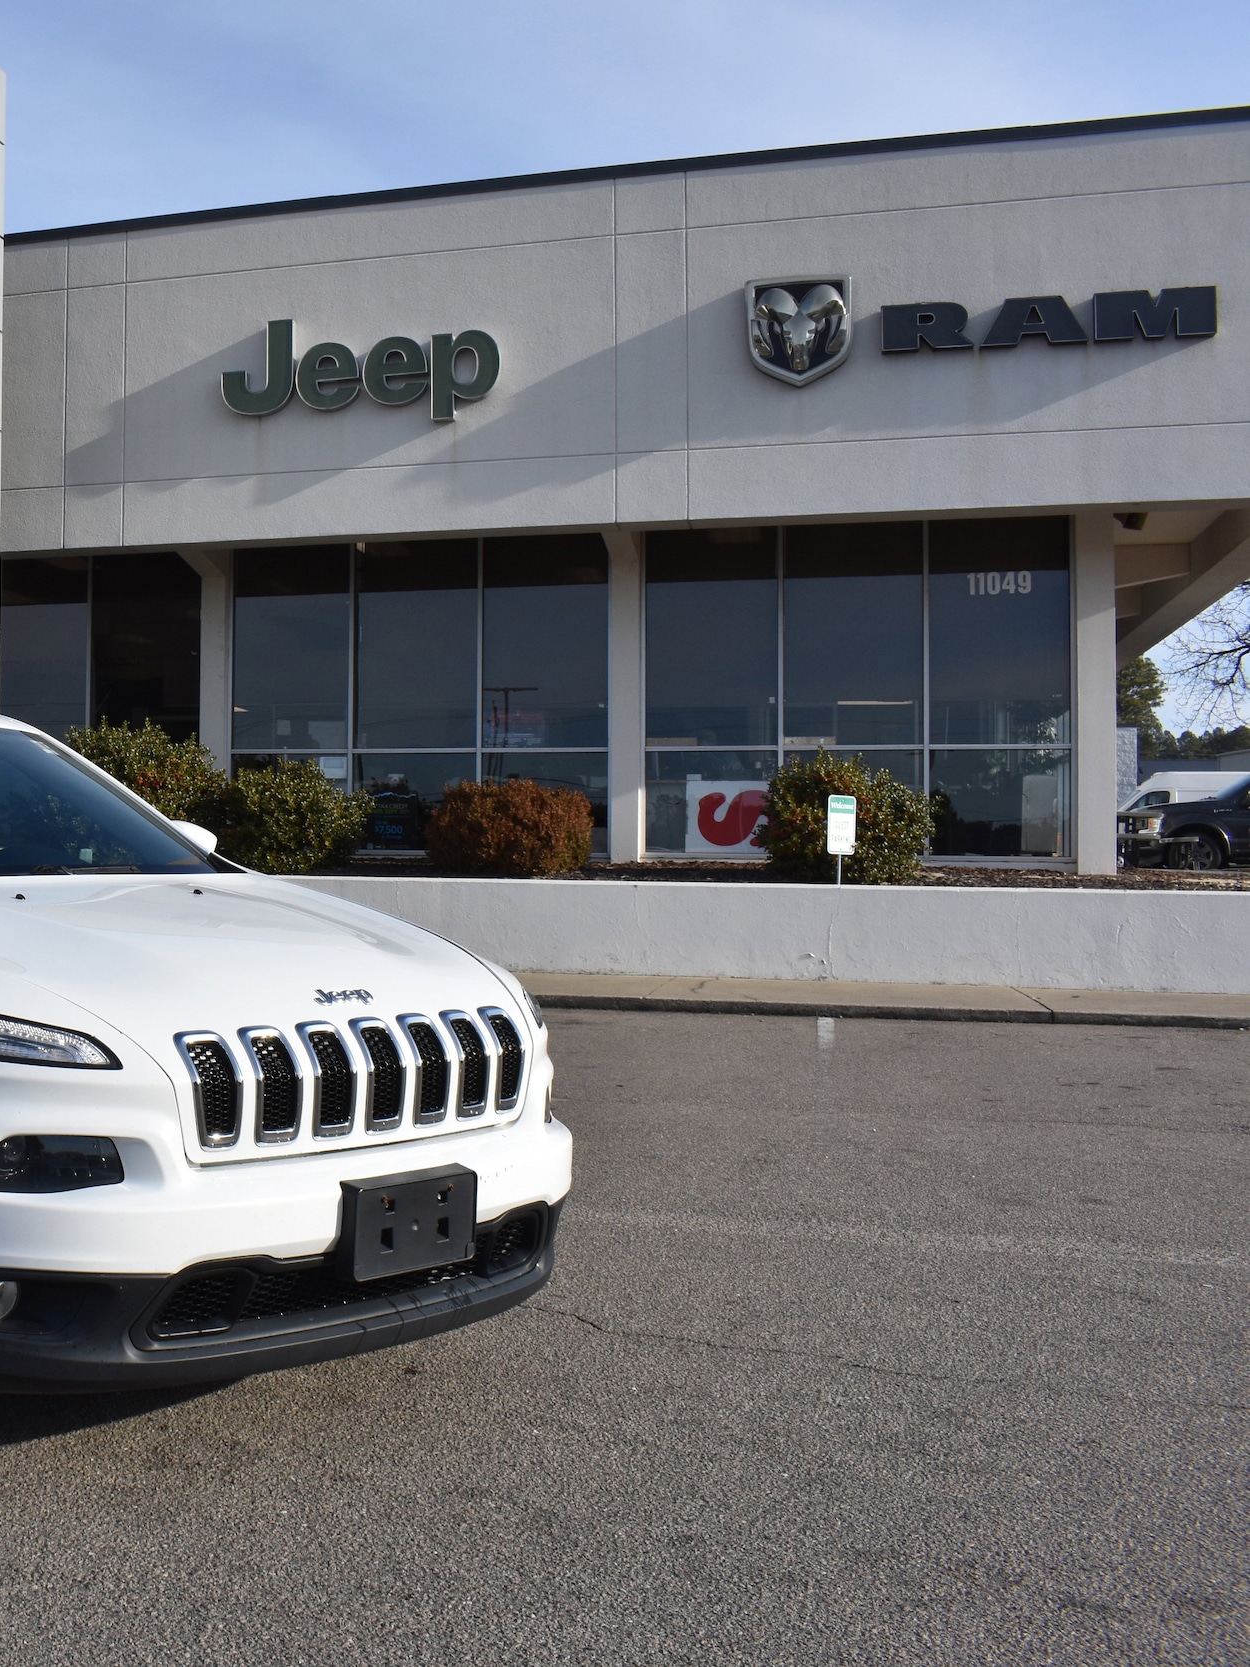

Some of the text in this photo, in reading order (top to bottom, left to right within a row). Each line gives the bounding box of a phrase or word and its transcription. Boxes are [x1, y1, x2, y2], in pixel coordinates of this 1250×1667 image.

[881, 286, 1217, 355] RAM
[221, 319, 500, 421] Jeep
[967, 570, 1032, 595] 11049
[313, 989, 374, 1006] Jeep
